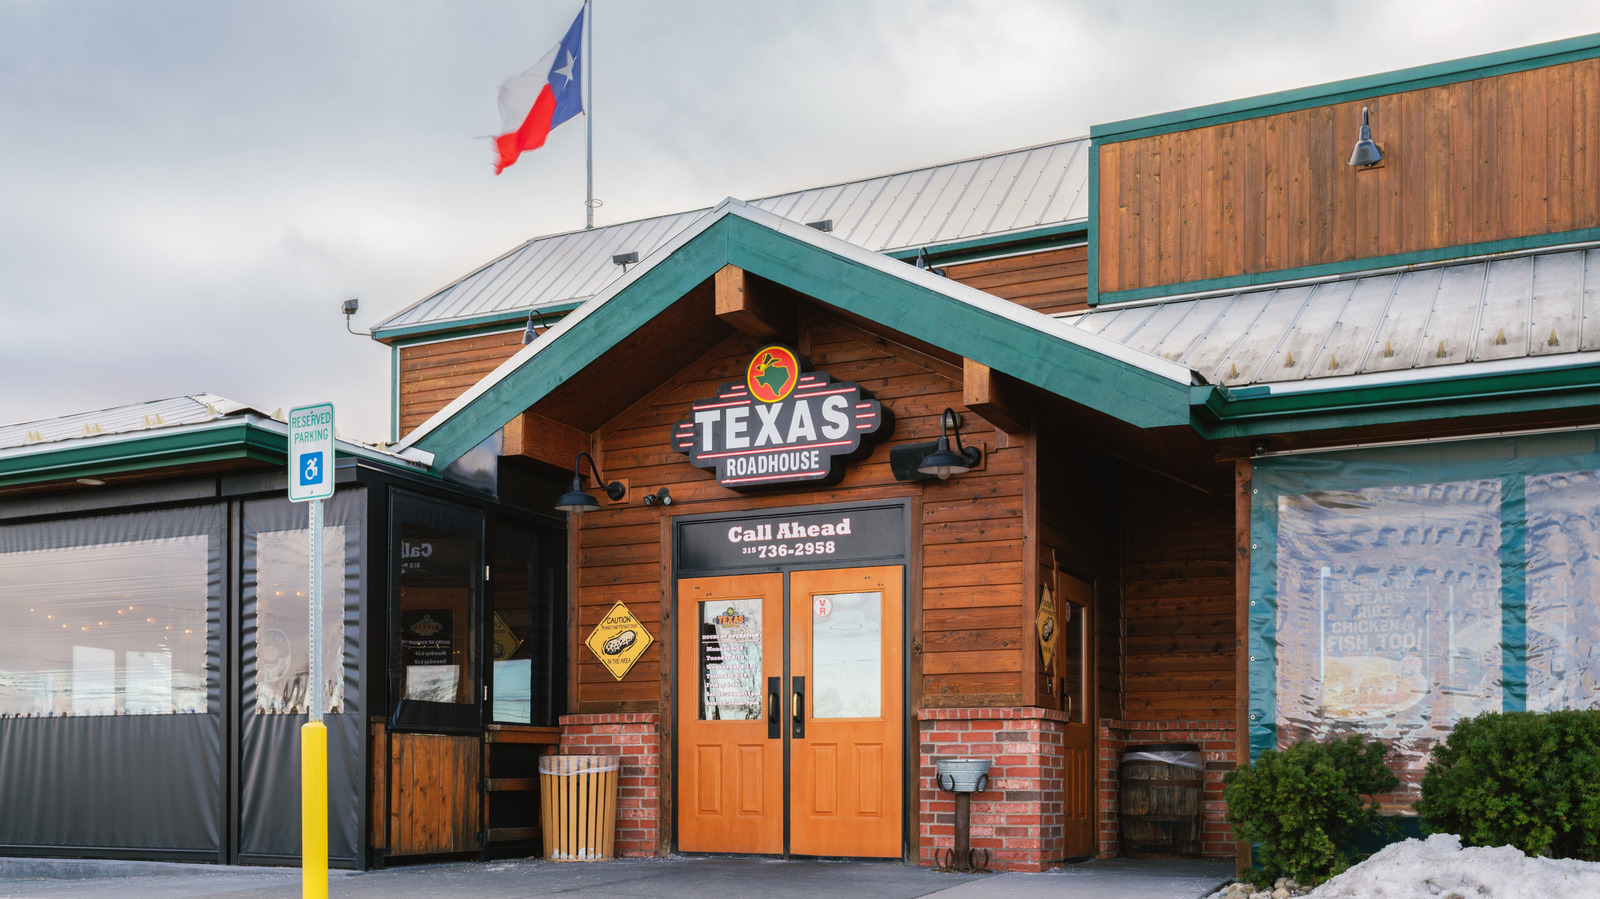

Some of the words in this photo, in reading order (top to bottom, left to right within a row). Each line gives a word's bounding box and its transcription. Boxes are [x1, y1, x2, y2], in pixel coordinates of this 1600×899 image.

[292, 412, 331, 429] RESERVED
[694, 395, 850, 452] TEXAS
[294, 428, 329, 444] PARKING
[726, 450, 820, 477] ROADHOUSE
[728, 524, 773, 543] Call
[776, 518, 851, 540] Ahead
[742, 546, 756, 555] 315
[758, 541, 836, 558] 736-2958
[819, 607, 826, 615] R
[607, 616, 631, 624] CAUTION
[717, 615, 744, 625] TEXAS
[1331, 619, 1400, 633] CHICKEN
[1377, 628, 1424, 650] TOO!
